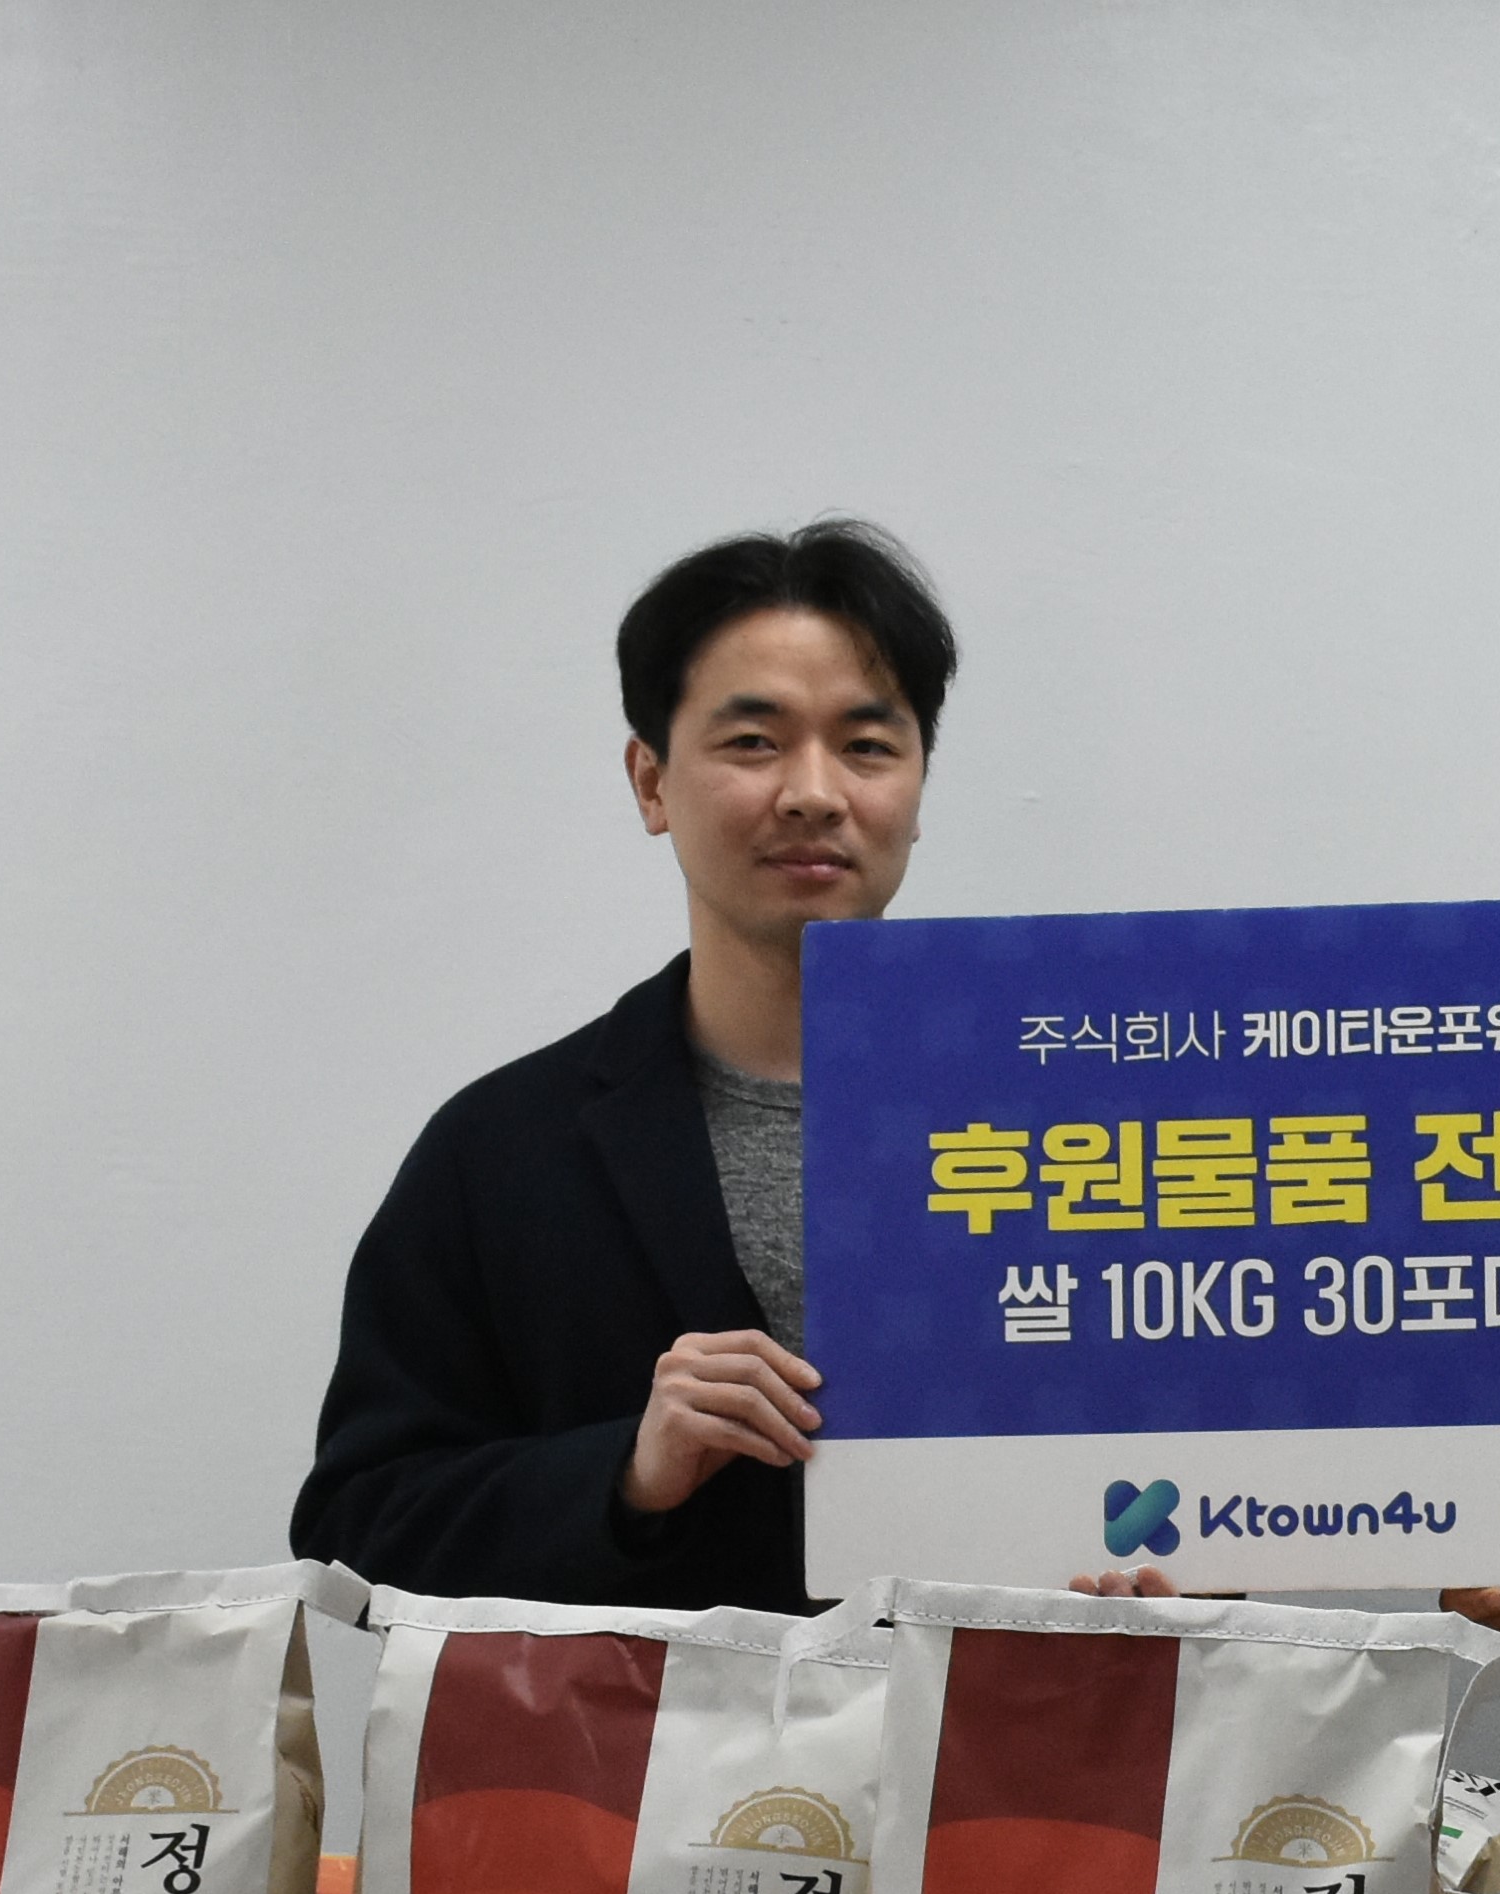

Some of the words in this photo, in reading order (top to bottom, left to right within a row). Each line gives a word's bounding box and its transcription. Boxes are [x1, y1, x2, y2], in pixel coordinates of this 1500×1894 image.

[1018, 1011, 1226, 1066] 주식회사
[927, 1115, 1372, 1235] 후원물품
[997, 1263, 1079, 1344] 쌀
[1100, 1257, 1276, 1341] 10KG
[1198, 1489, 1457, 1539] Ktown4u
